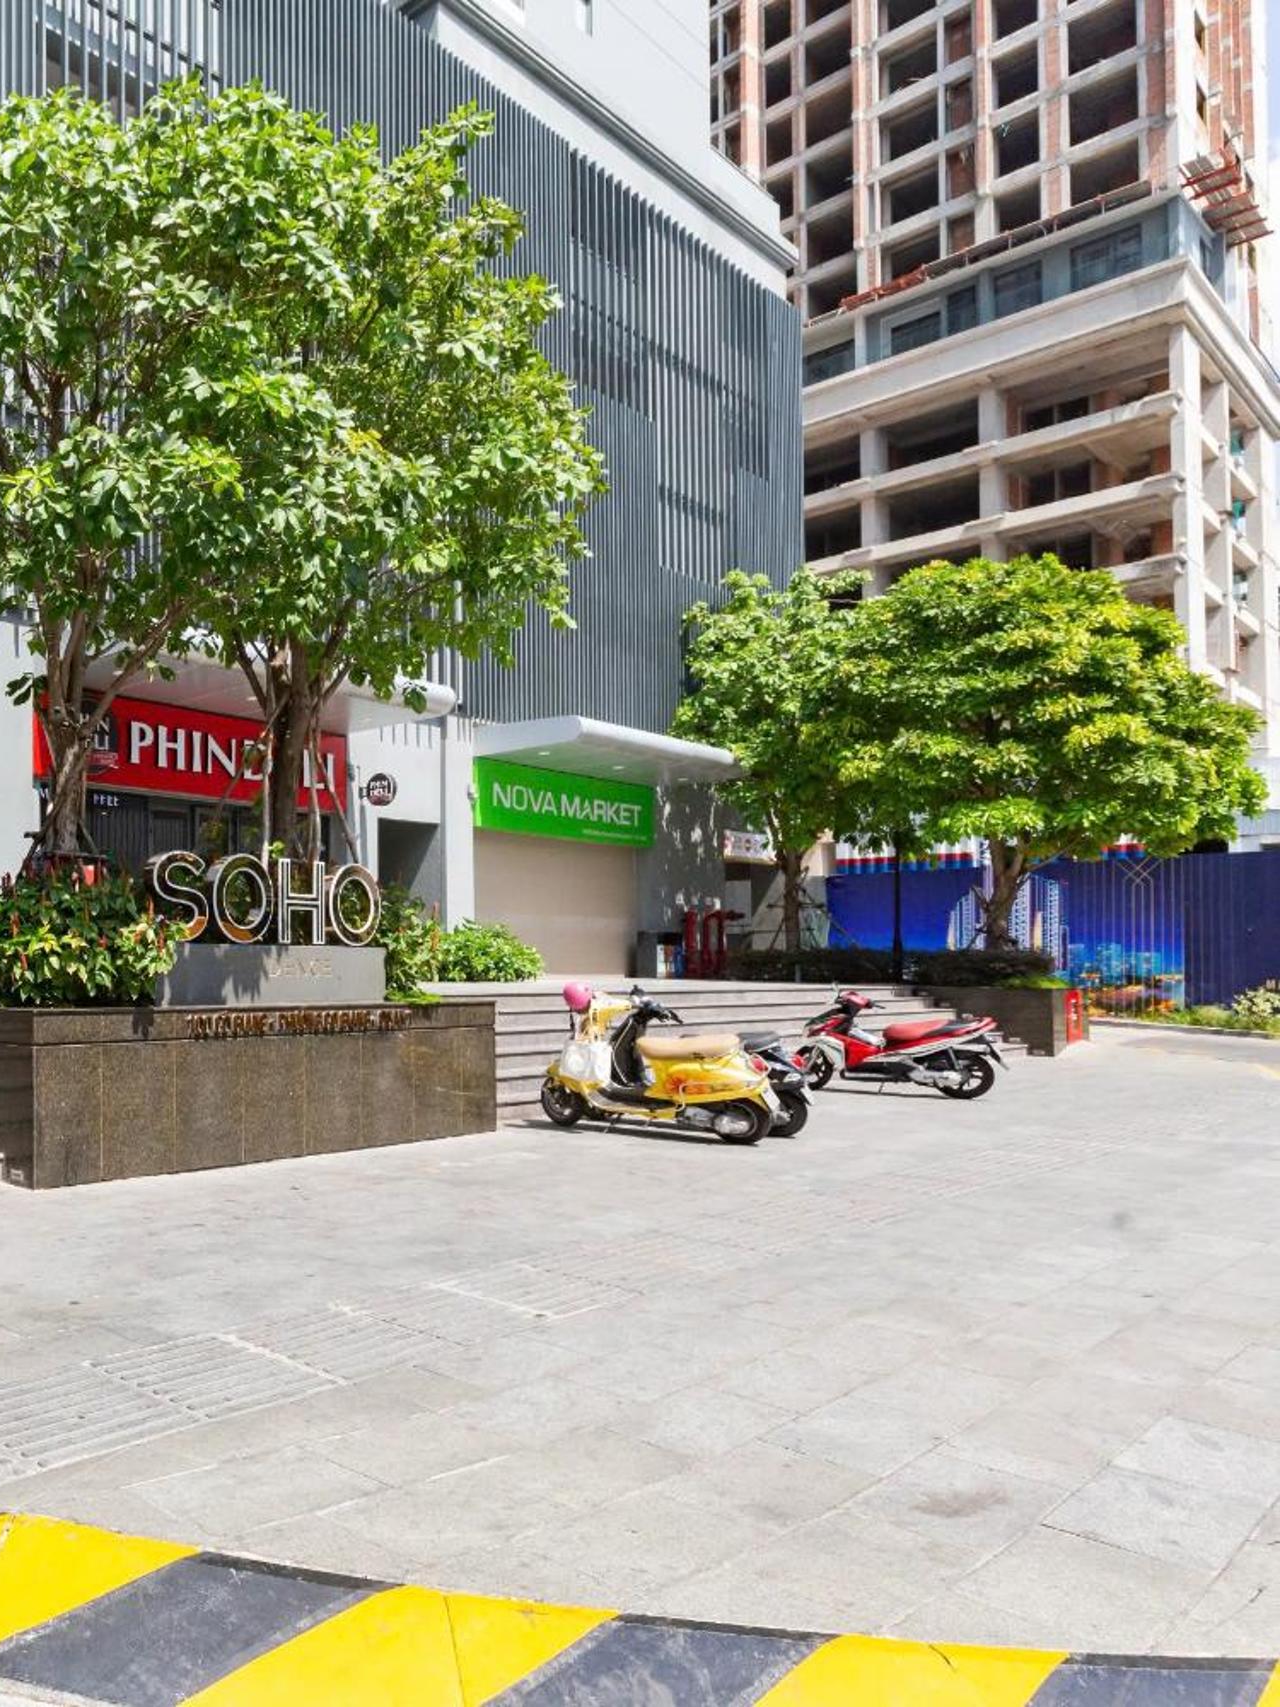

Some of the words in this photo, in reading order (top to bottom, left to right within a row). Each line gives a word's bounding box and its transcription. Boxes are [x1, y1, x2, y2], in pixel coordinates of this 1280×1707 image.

[129, 719, 335, 793] PHINDLI
[491, 781, 558, 817] NOVA
[560, 793, 642, 828] MARKET
[151, 850, 382, 947] SOHO
